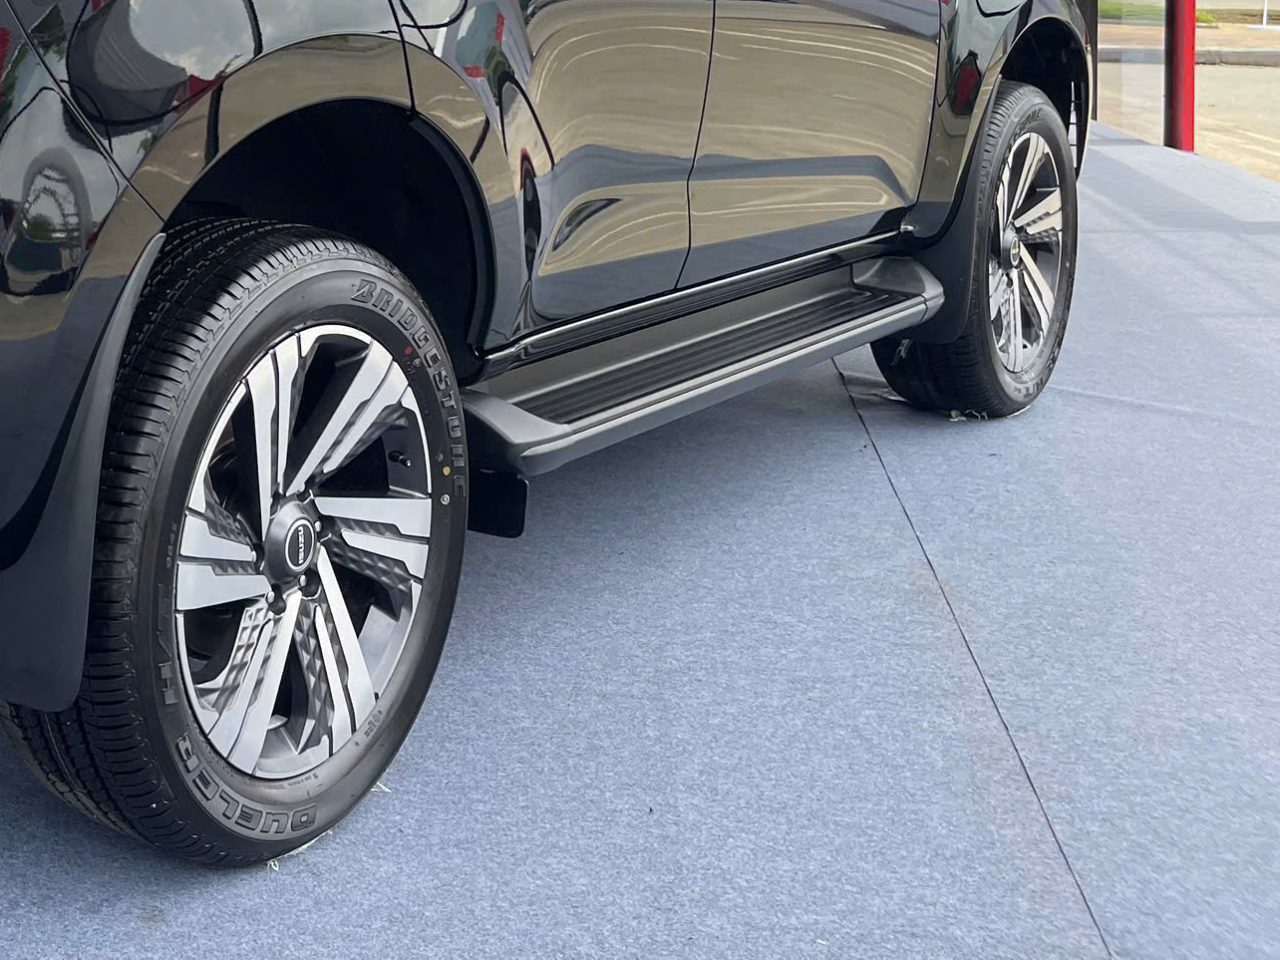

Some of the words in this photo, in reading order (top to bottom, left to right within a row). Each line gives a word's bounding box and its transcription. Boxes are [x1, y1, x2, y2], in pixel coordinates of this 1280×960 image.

[352, 278, 466, 497] BRIDGESTONE
[297, 525, 305, 564] ISUZU
[176, 735, 318, 835] DUELER
